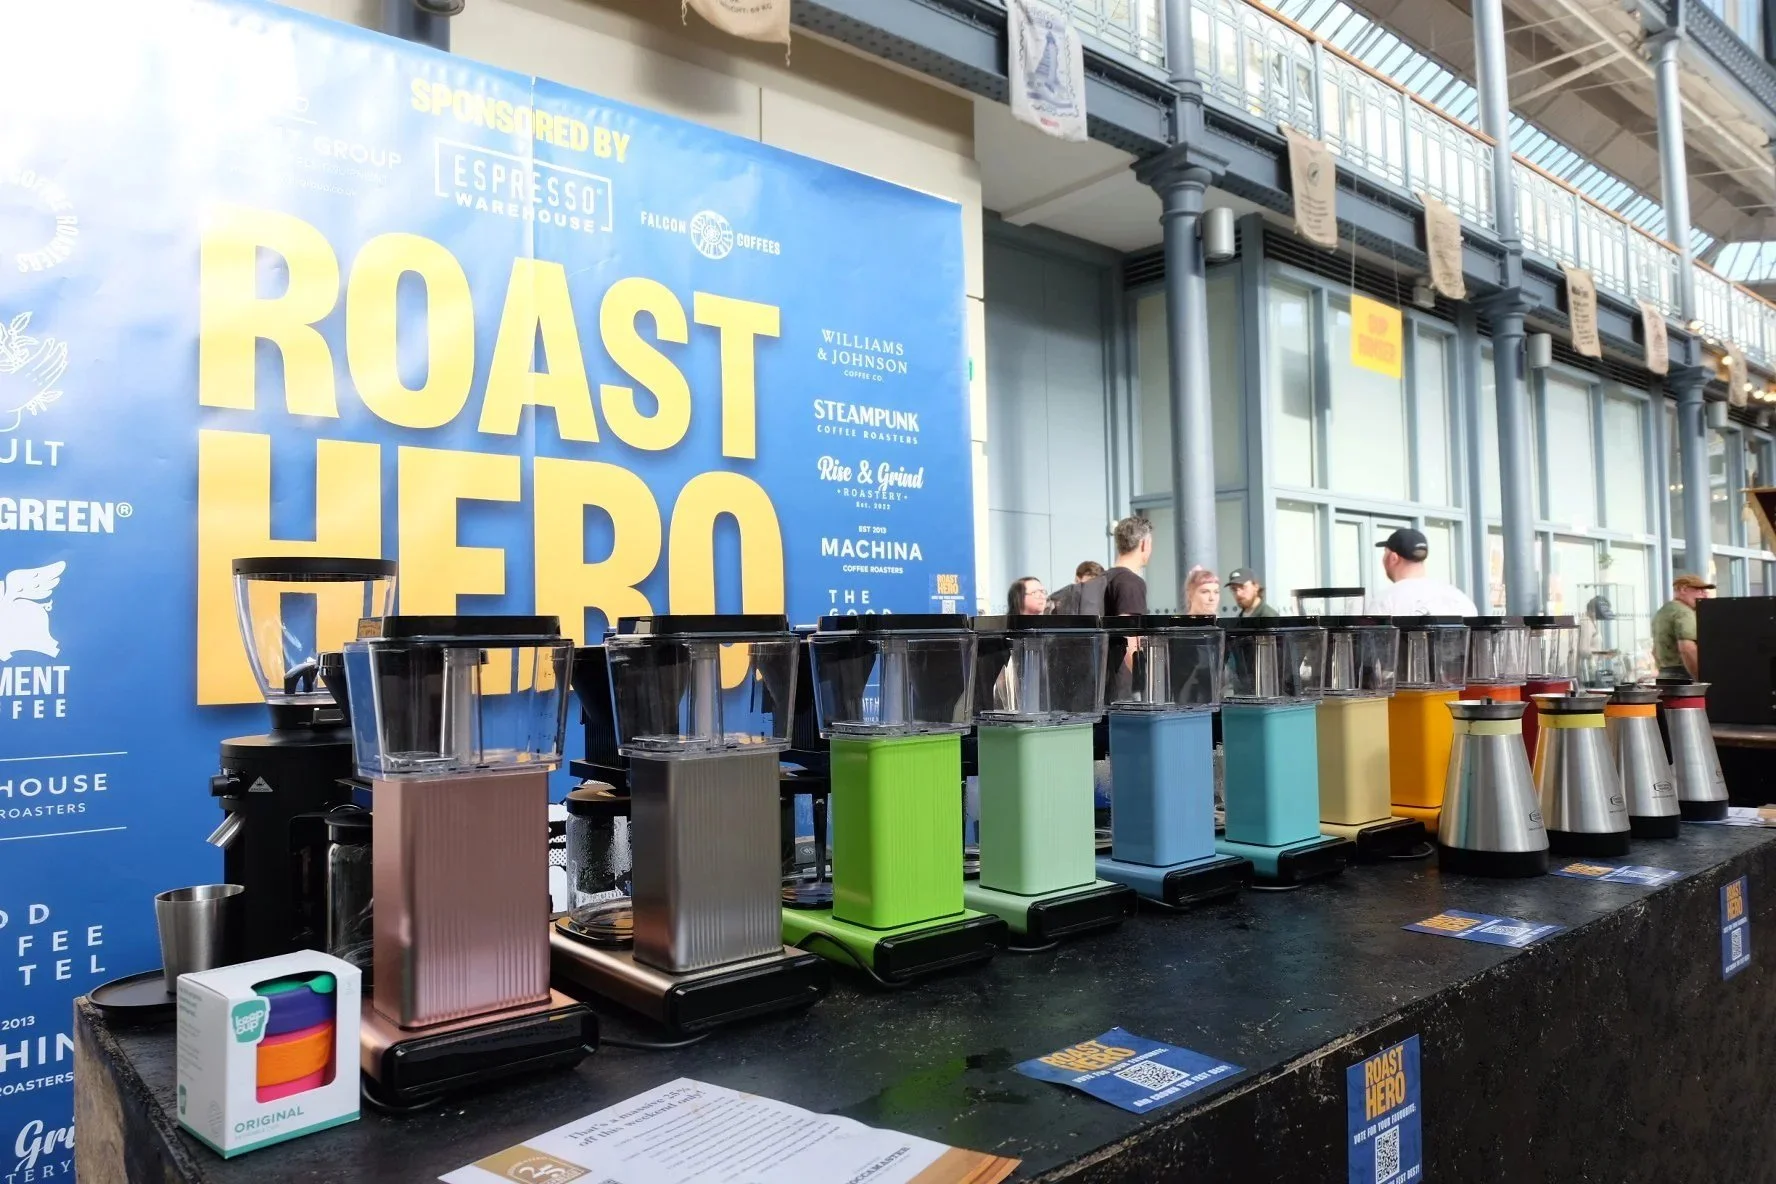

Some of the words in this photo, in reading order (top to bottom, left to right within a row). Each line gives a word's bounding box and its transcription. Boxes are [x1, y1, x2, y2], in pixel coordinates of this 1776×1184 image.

[411, 78, 590, 152] SPONSORED
[593, 126, 630, 163] BY
[313, 135, 402, 169] GROUP
[454, 154, 596, 215] ESPRESSO
[456, 191, 595, 234] WAREHOUSE
[640, 211, 686, 234] FALCON
[737, 233, 781, 256] COFFEES
[198, 205, 781, 459] ROAST
[822, 328, 904, 356] WILLIAMS
[817, 348, 827, 361] &
[832, 351, 908, 374] JOHNSON
[844, 370, 870, 380] COFFEE
[813, 399, 920, 433] STEAMPUNK
[817, 424, 857, 437] COFFEE
[863, 430, 918, 444] ROASTERS
[817, 455, 852, 482] Rise
[857, 460, 873, 484] &
[877, 462, 924, 494] Grind
[843, 487, 902, 501] ROASTERY
[858, 525, 871, 533] EST
[872, 526, 887, 534] 2013
[821, 538, 923, 561] MACHINA
[197, 428, 785, 705] HERO
[842, 565, 869, 573] COFFEE
[870, 566, 903, 574] ROASTERS
[829, 590, 870, 604] THE
[18, 925, 103, 957] FEE
[18, 955, 105, 986] TEL
[1, 1015, 35, 1031] 2013
[236, 1010, 265, 1027] keep
[236, 1020, 259, 1035] cup
[1039, 1040, 1109, 1067] ROAST
[1062, 1047, 1136, 1072] HERO
[1365, 1045, 1404, 1087] ROAST
[619, 1098, 665, 1119] massive
[1366, 1071, 1406, 1121] HERO
[234, 1106, 305, 1133] ORIGINAL
[578, 1136, 598, 1148] off
[599, 1126, 624, 1138] this
[624, 1102, 678, 1127] weekend
